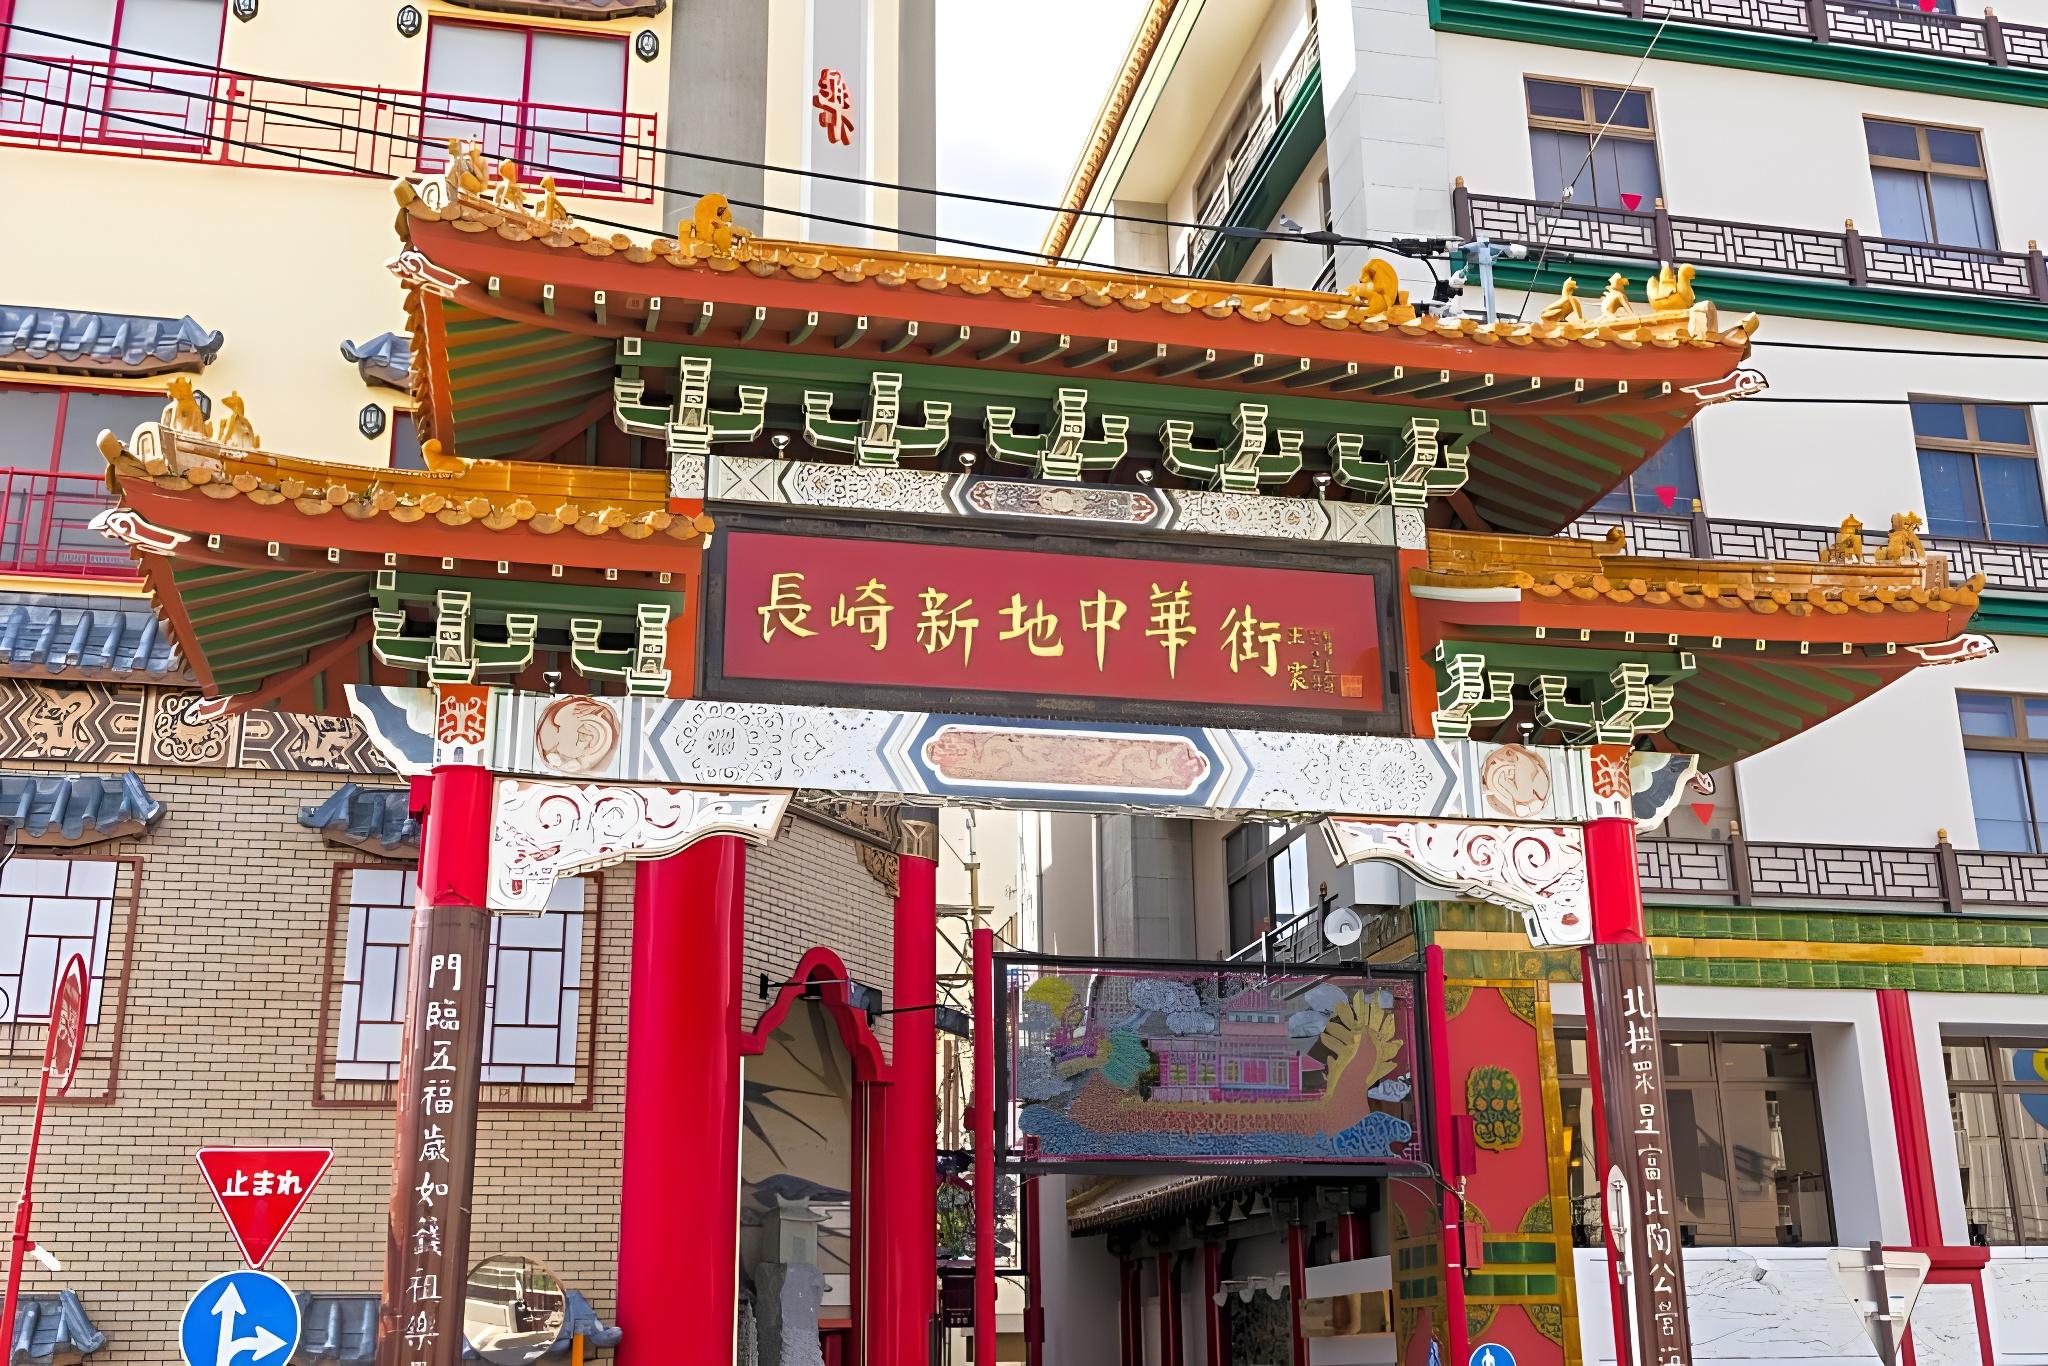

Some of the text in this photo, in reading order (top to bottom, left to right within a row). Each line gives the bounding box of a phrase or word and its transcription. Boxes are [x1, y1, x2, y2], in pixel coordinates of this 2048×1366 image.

[757, 572, 1281, 680] 長崎新地中華街
[221, 1169, 303, 1197] 止まれ
